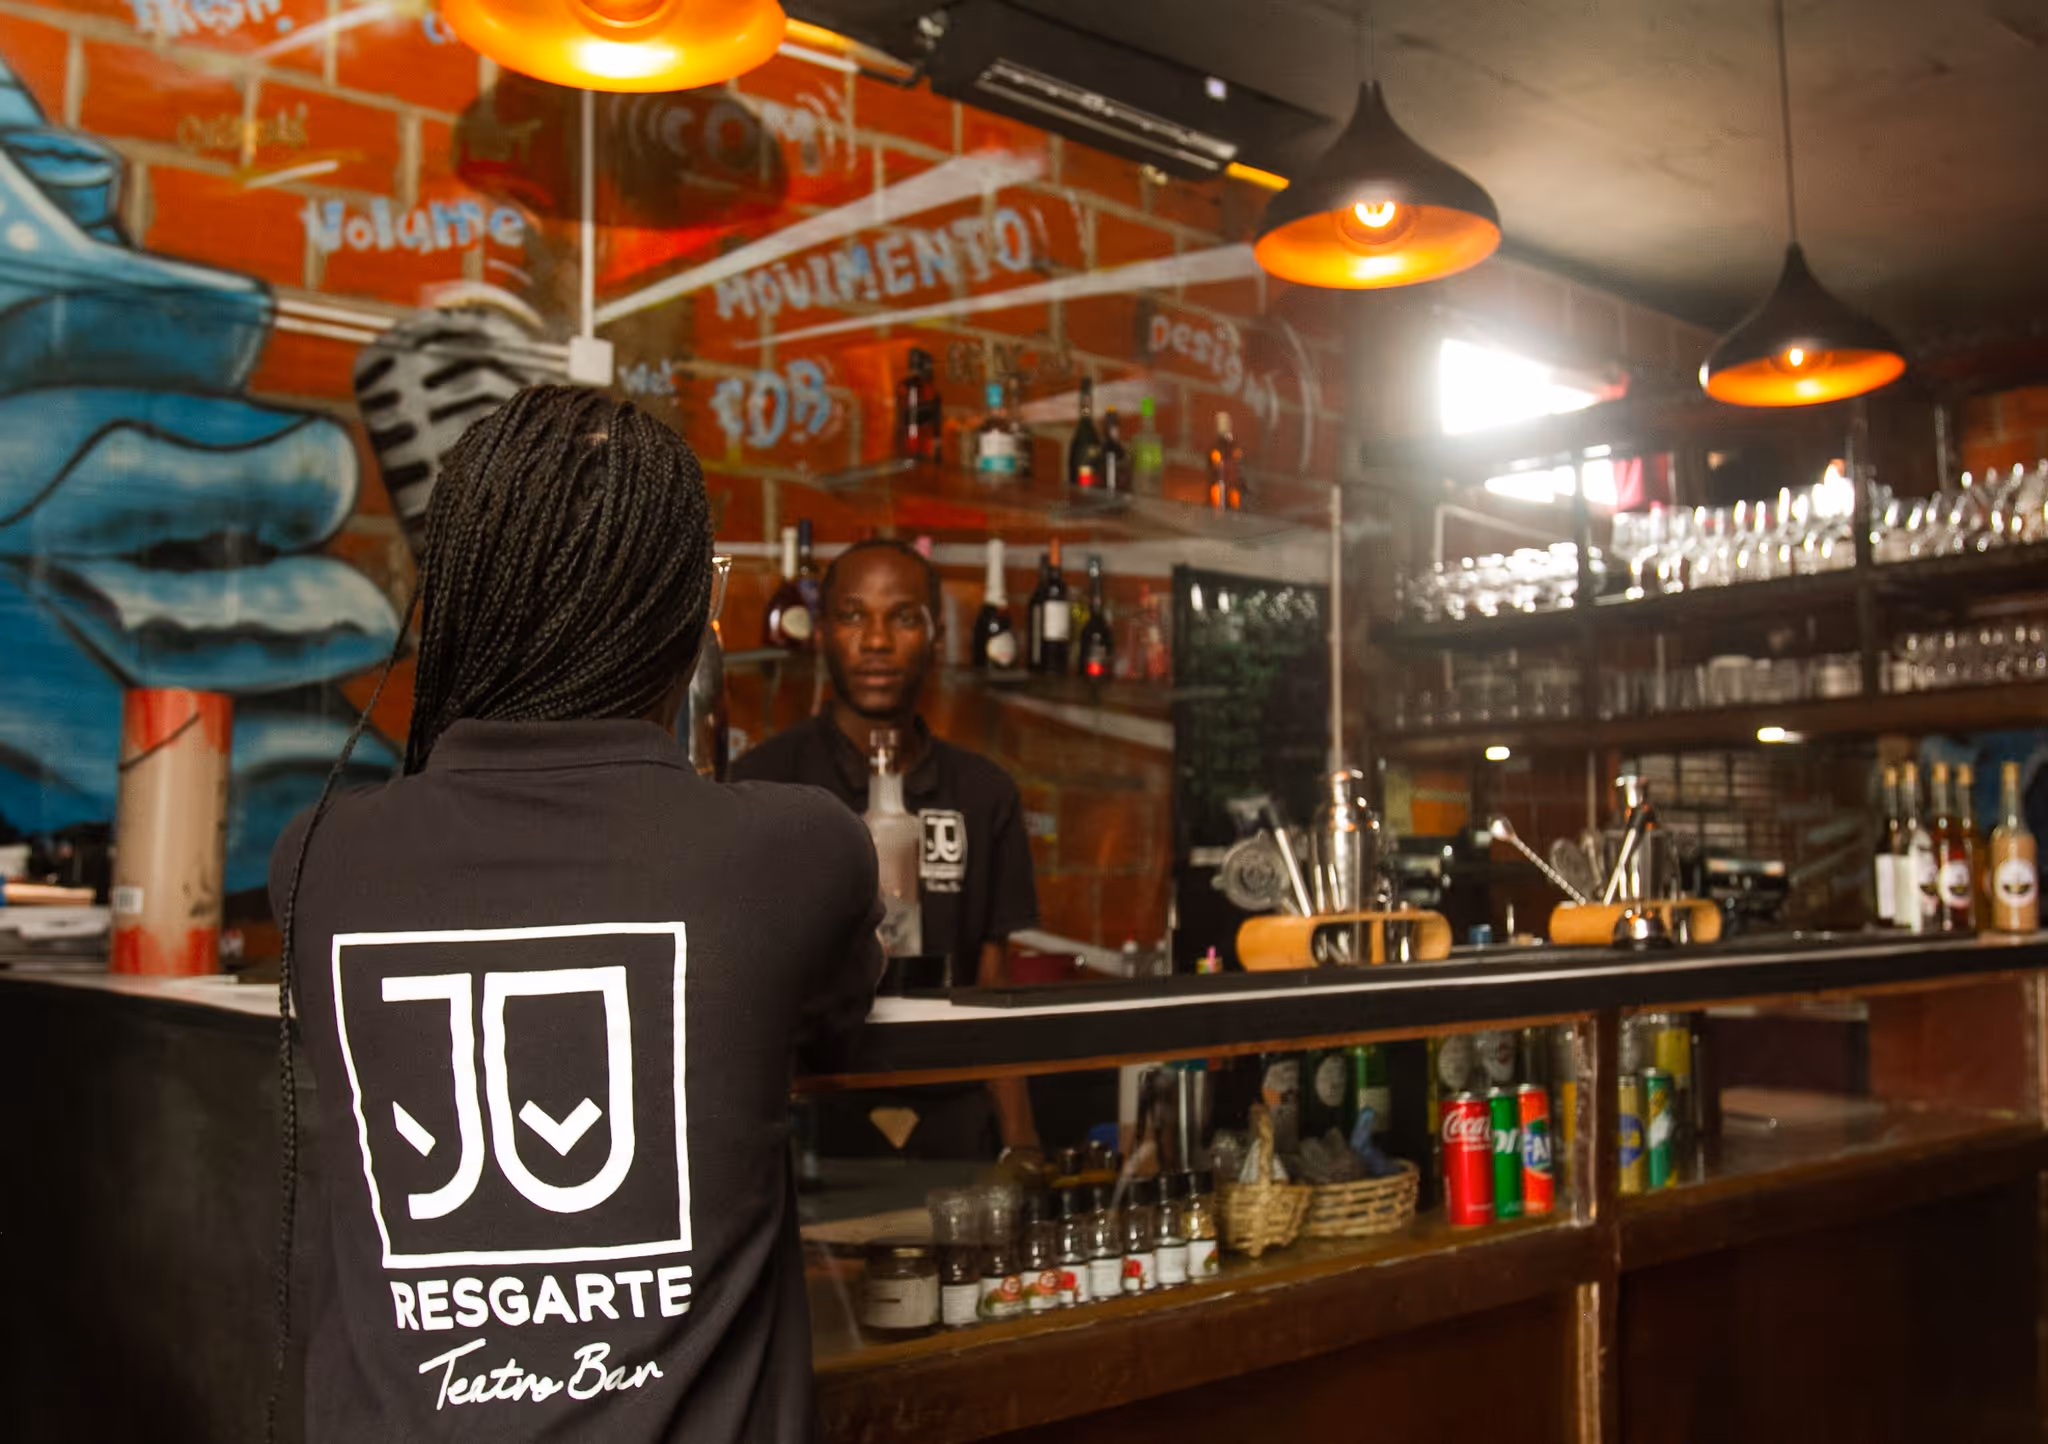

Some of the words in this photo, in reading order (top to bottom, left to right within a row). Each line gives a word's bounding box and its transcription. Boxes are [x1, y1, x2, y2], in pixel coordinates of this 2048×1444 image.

[389, 1265, 693, 1331] RESGARTE
[418, 1337, 564, 1411] Teatro
[567, 1341, 664, 1400] Bar
